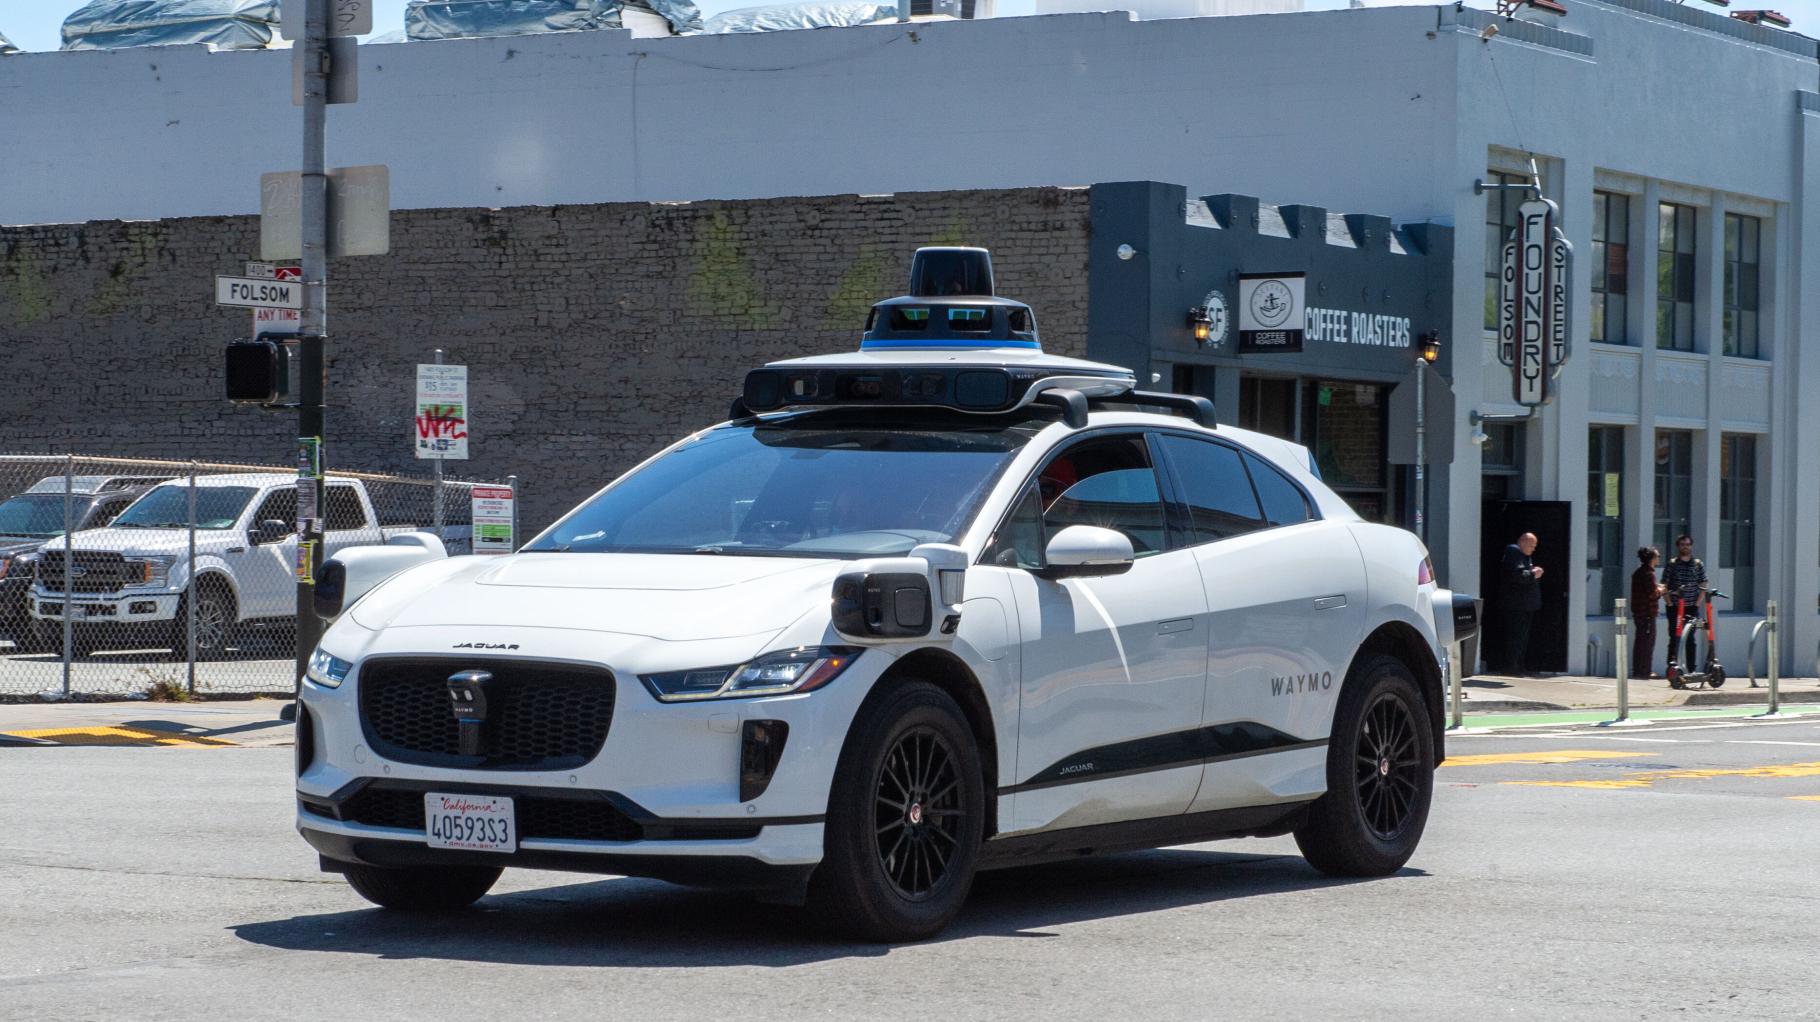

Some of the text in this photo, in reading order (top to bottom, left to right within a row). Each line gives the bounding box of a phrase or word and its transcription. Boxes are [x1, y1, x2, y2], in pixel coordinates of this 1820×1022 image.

[231, 283, 289, 303] FOLSOM
[1503, 245, 1515, 360] FOLSOM
[1522, 213, 1543, 392] FOUNDRY
[1553, 245, 1564, 361] STREET
[257, 308, 298, 320] ANY TIME
[1208, 306, 1222, 332] SF
[1304, 306, 1411, 348] COFFEE ROASTERS
[1255, 332, 1287, 340] COFFEE
[452, 642, 520, 650] JAGUAR
[1271, 671, 1332, 697] WAYMO
[1060, 762, 1094, 775] JAGUAR
[443, 798, 496, 815] California
[432, 813, 509, 844] 40593S3
